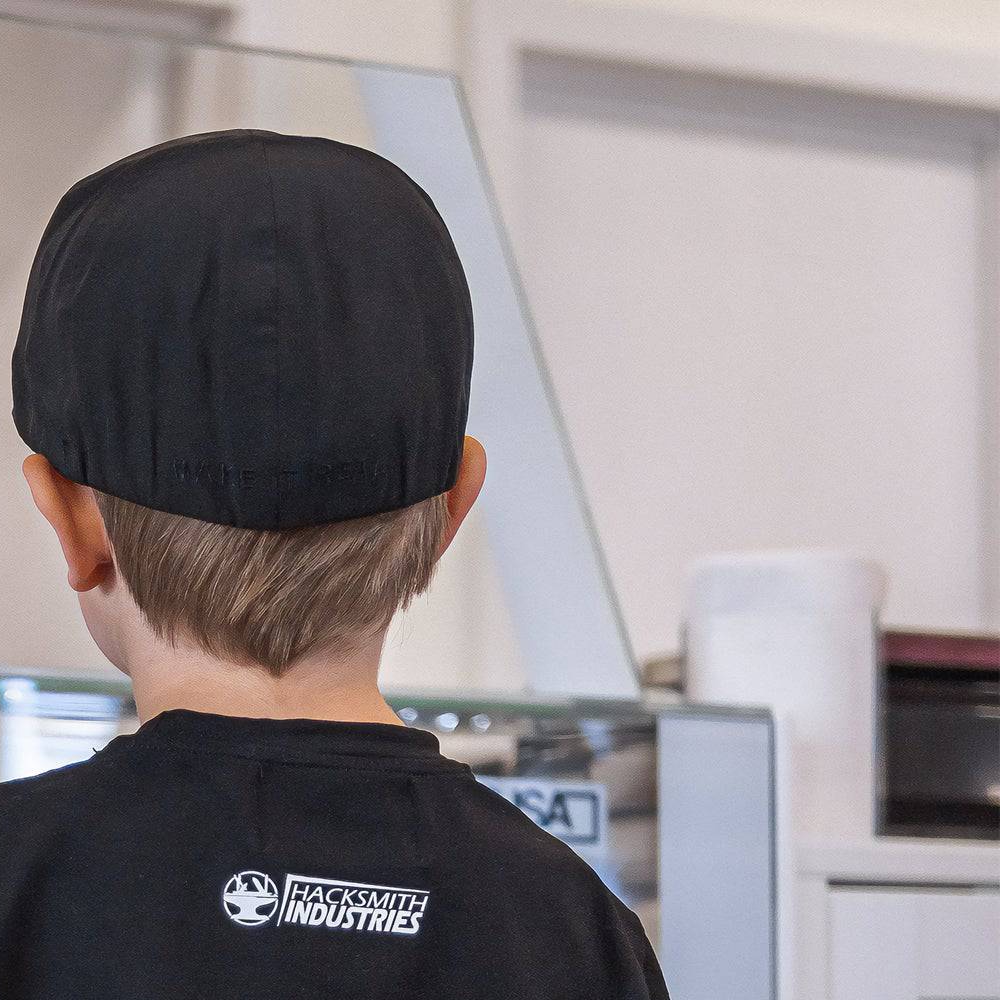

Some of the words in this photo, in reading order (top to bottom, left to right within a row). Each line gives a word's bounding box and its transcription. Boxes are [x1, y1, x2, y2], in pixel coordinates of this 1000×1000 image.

[513, 788, 575, 828] SA
[290, 883, 429, 912] HACKSMITH
[284, 900, 424, 935] INDUSTRIES
